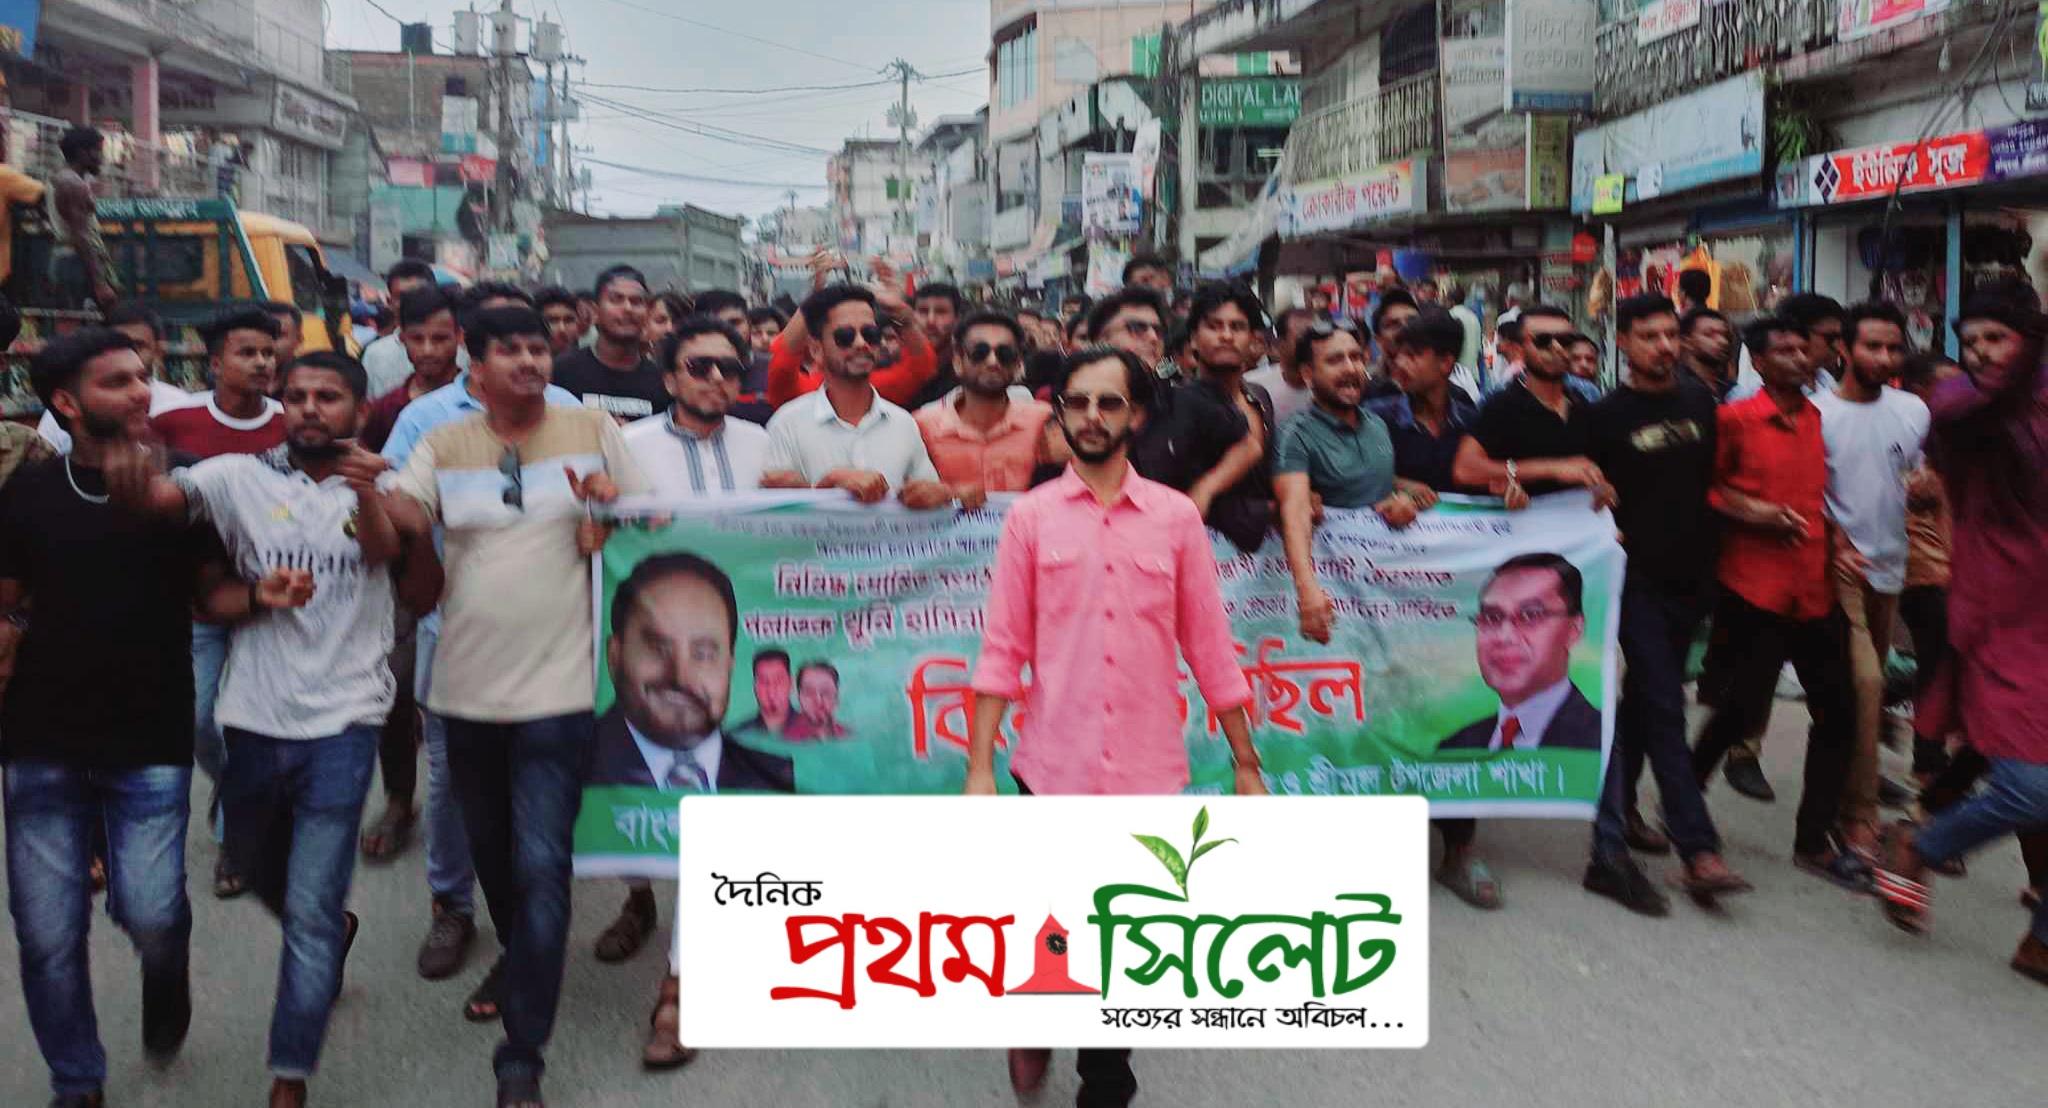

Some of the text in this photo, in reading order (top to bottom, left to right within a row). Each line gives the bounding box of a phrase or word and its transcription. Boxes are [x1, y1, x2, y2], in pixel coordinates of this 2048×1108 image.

[1201, 83, 1265, 108] DIGITAL
[1853, 145, 1918, 192] ইউনিক
[841, 602, 896, 649] খুনি
[1390, 755, 1480, 794] উপজেলা
